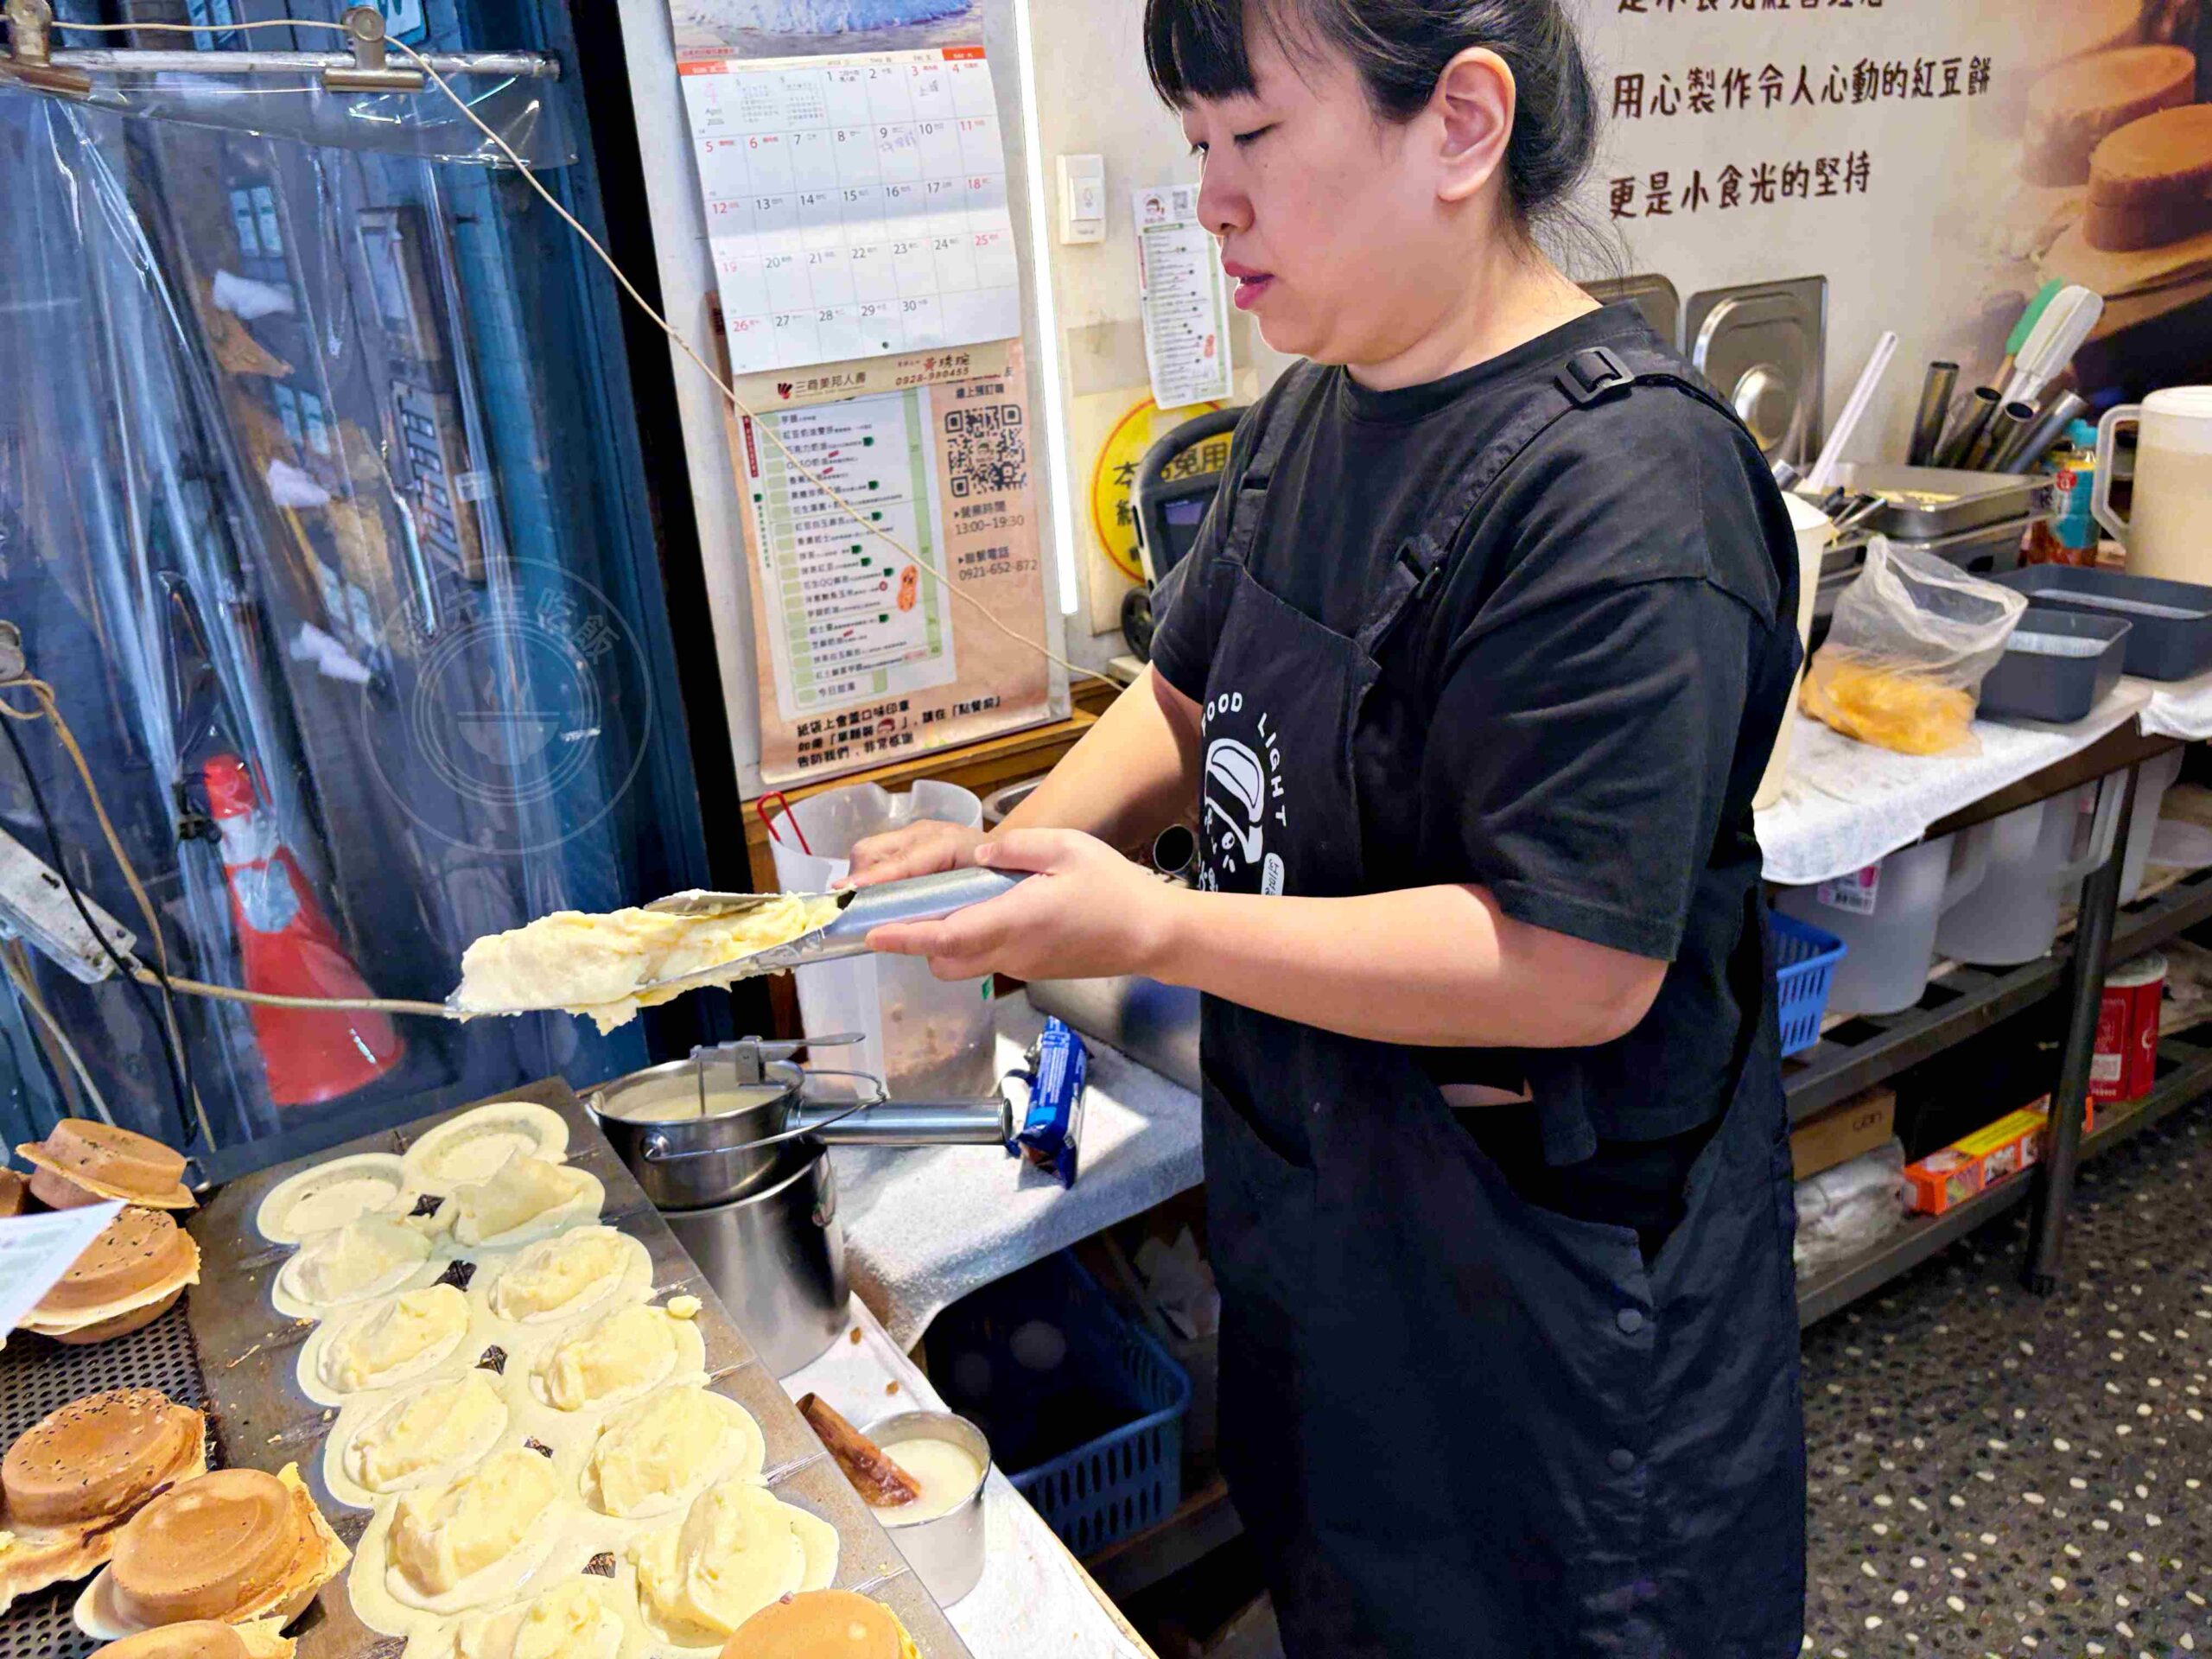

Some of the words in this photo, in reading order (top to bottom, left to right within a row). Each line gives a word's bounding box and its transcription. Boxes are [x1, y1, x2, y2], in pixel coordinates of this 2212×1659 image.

[912, 66, 919, 76] 3
[952, 63, 959, 73] 4
[827, 72, 833, 81] 1
[869, 69, 878, 79] 2
[1611, 55, 1992, 119] 用心製作令人心動的紅豆餅
[919, 124, 933, 134] 10
[960, 121, 972, 130] 11
[837, 131, 845, 142] 8
[880, 127, 887, 138] 9
[749, 137, 758, 149] 6
[794, 134, 801, 145] 7
[706, 141, 714, 152] 5
[927, 182, 940, 194] 17
[969, 179, 981, 189] 18
[1609, 150, 1871, 220] 更是小食光的堅持
[843, 190, 857, 201] 15
[886, 187, 899, 197] 16
[756, 199, 771, 210] 13
[800, 195, 814, 206] 14
[713, 203, 728, 214] 12
[935, 239, 949, 250] 24
[976, 235, 988, 245] 25
[852, 248, 865, 259] 22
[893, 244, 907, 255] 23
[766, 257, 780, 269] 20
[810, 253, 822, 264] 21
[722, 262, 737, 273] 19
[861, 305, 875, 316] 29
[903, 301, 917, 311] 30
[776, 315, 790, 327] 27
[819, 310, 833, 321] 28
[734, 321, 748, 332] 26
[1257, 712, 1287, 826] LIGHT
